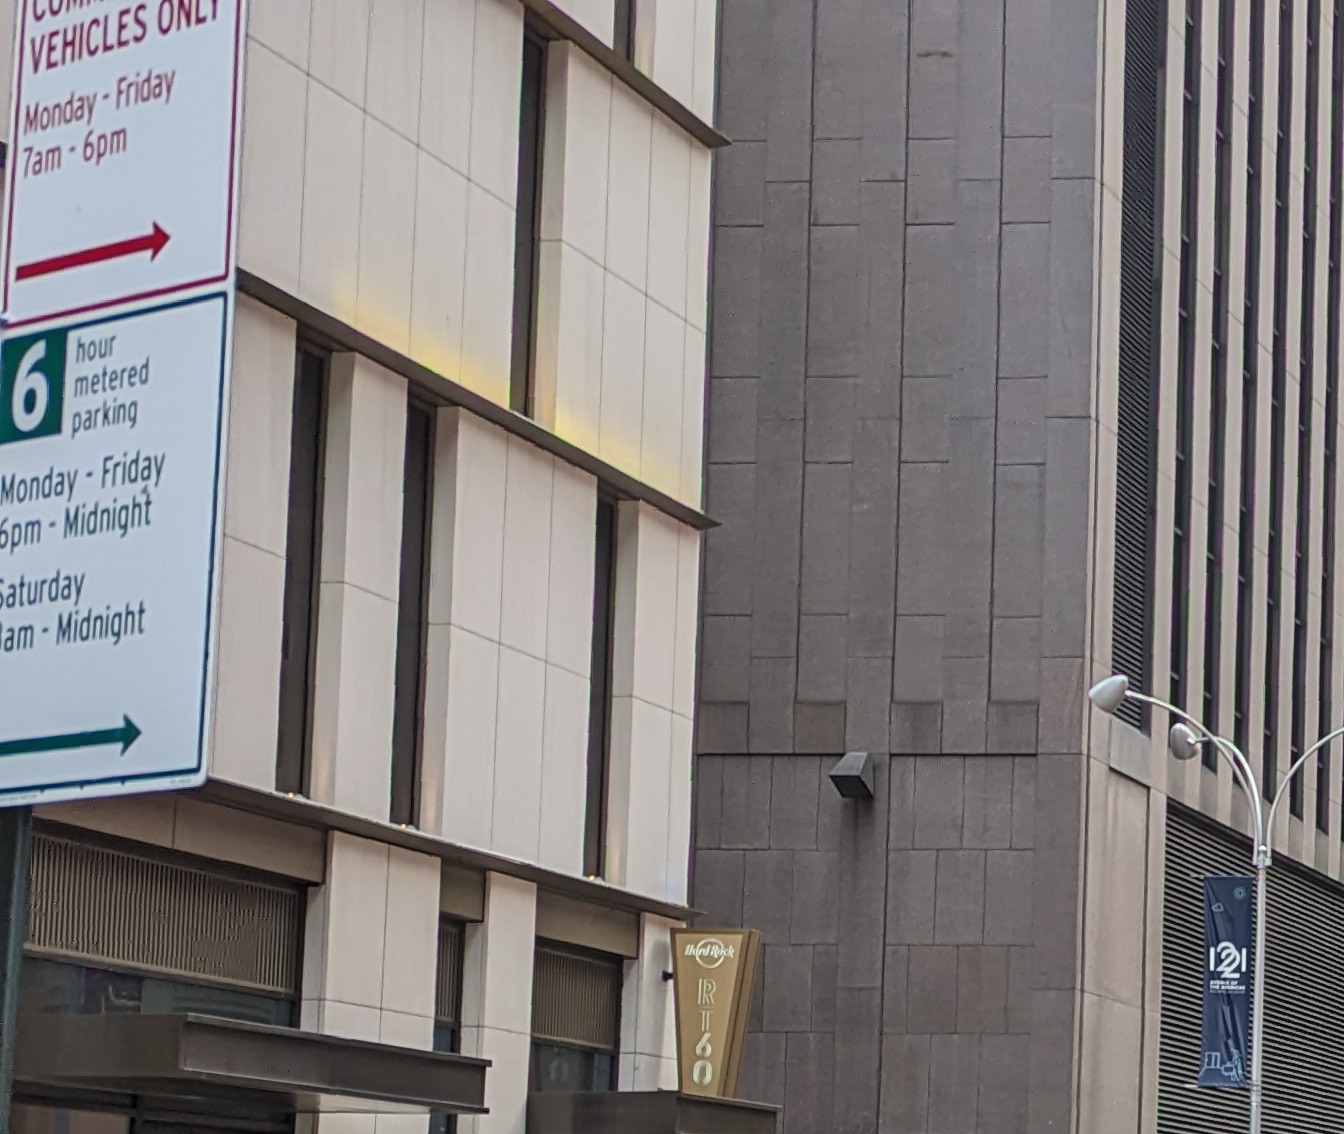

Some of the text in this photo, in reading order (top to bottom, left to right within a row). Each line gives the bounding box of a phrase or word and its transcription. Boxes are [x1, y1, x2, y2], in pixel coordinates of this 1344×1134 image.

[31, 0, 218, 74] VEHICLES ONLY
[24, 91, 97, 135] Monday
[116, 68, 176, 109] Friday
[23, 146, 62, 178] 7am
[83, 127, 127, 166] 6pm
[76, 333, 117, 363] hour
[11, 338, 48, 433] 6
[74, 358, 150, 398] metered
[71, 397, 138, 439] parking
[0, 466, 78, 506] Monday
[102, 449, 166, 489] Friday
[0, 517, 41, 554] 6pm
[63, 496, 154, 539] Midnight
[0, 624, 34, 653] am
[56, 600, 146, 646] Midnight
[684, 943, 735, 958] Hard Rock
[1209, 941, 1247, 978] 1221
